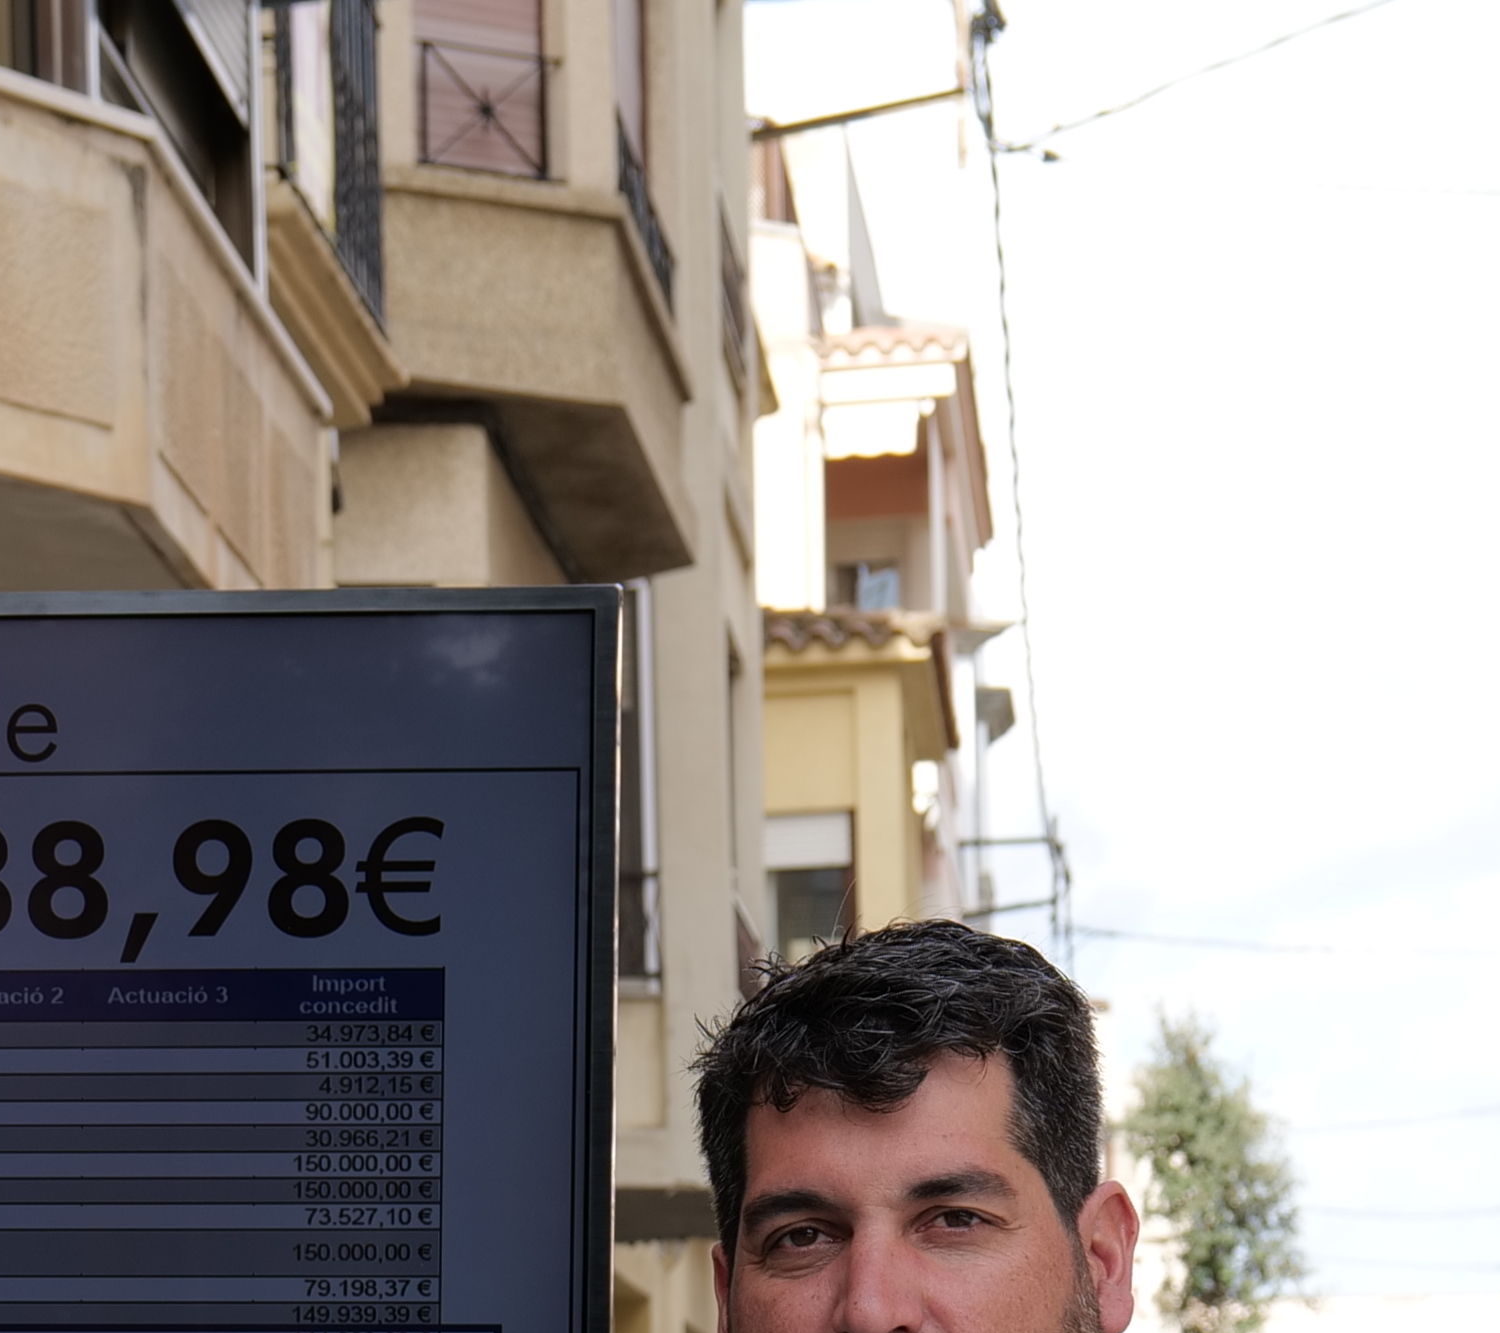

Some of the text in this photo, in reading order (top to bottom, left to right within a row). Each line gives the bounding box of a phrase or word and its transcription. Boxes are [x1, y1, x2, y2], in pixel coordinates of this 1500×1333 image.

[50, 986, 65, 1005] 2
[107, 985, 229, 1005] Actuació 3
[311, 974, 386, 997] Import
[298, 995, 398, 1015] concedit
[306, 1051, 435, 1072] 51.003,39 €
[293, 1154, 434, 1175] 150.000,00 €
[305, 1208, 433, 1229] 73.527,10 €
[304, 1279, 432, 1300] 79.198,37 €
